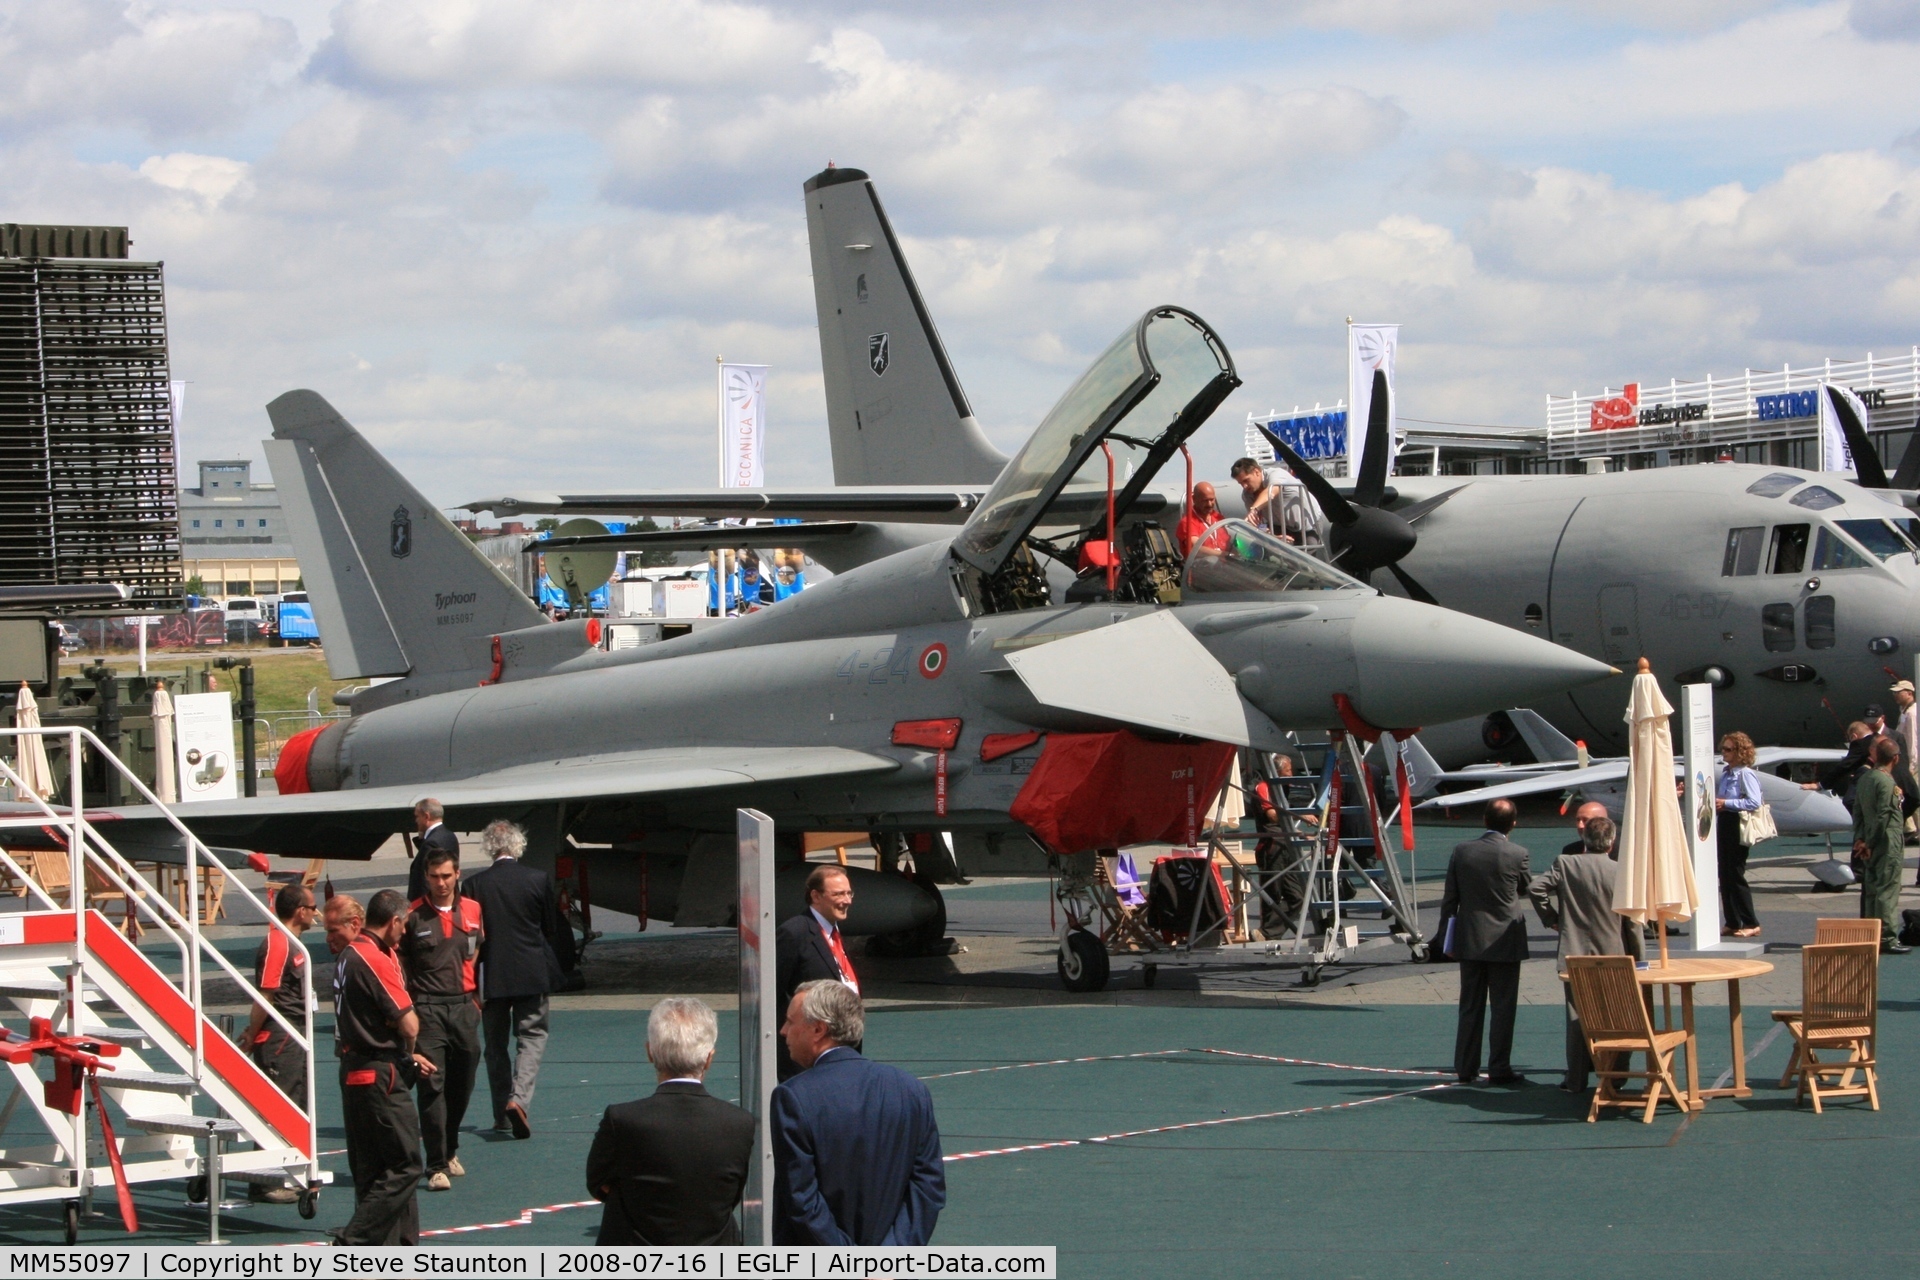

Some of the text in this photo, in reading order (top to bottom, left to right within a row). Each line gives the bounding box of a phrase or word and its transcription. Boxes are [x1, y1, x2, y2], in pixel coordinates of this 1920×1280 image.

[1639, 403, 1708, 427] Helicopter
[672, 582, 699, 591] aggreko
[435, 592, 477, 610] Typhoon
[837, 647, 914, 684] 4-24
